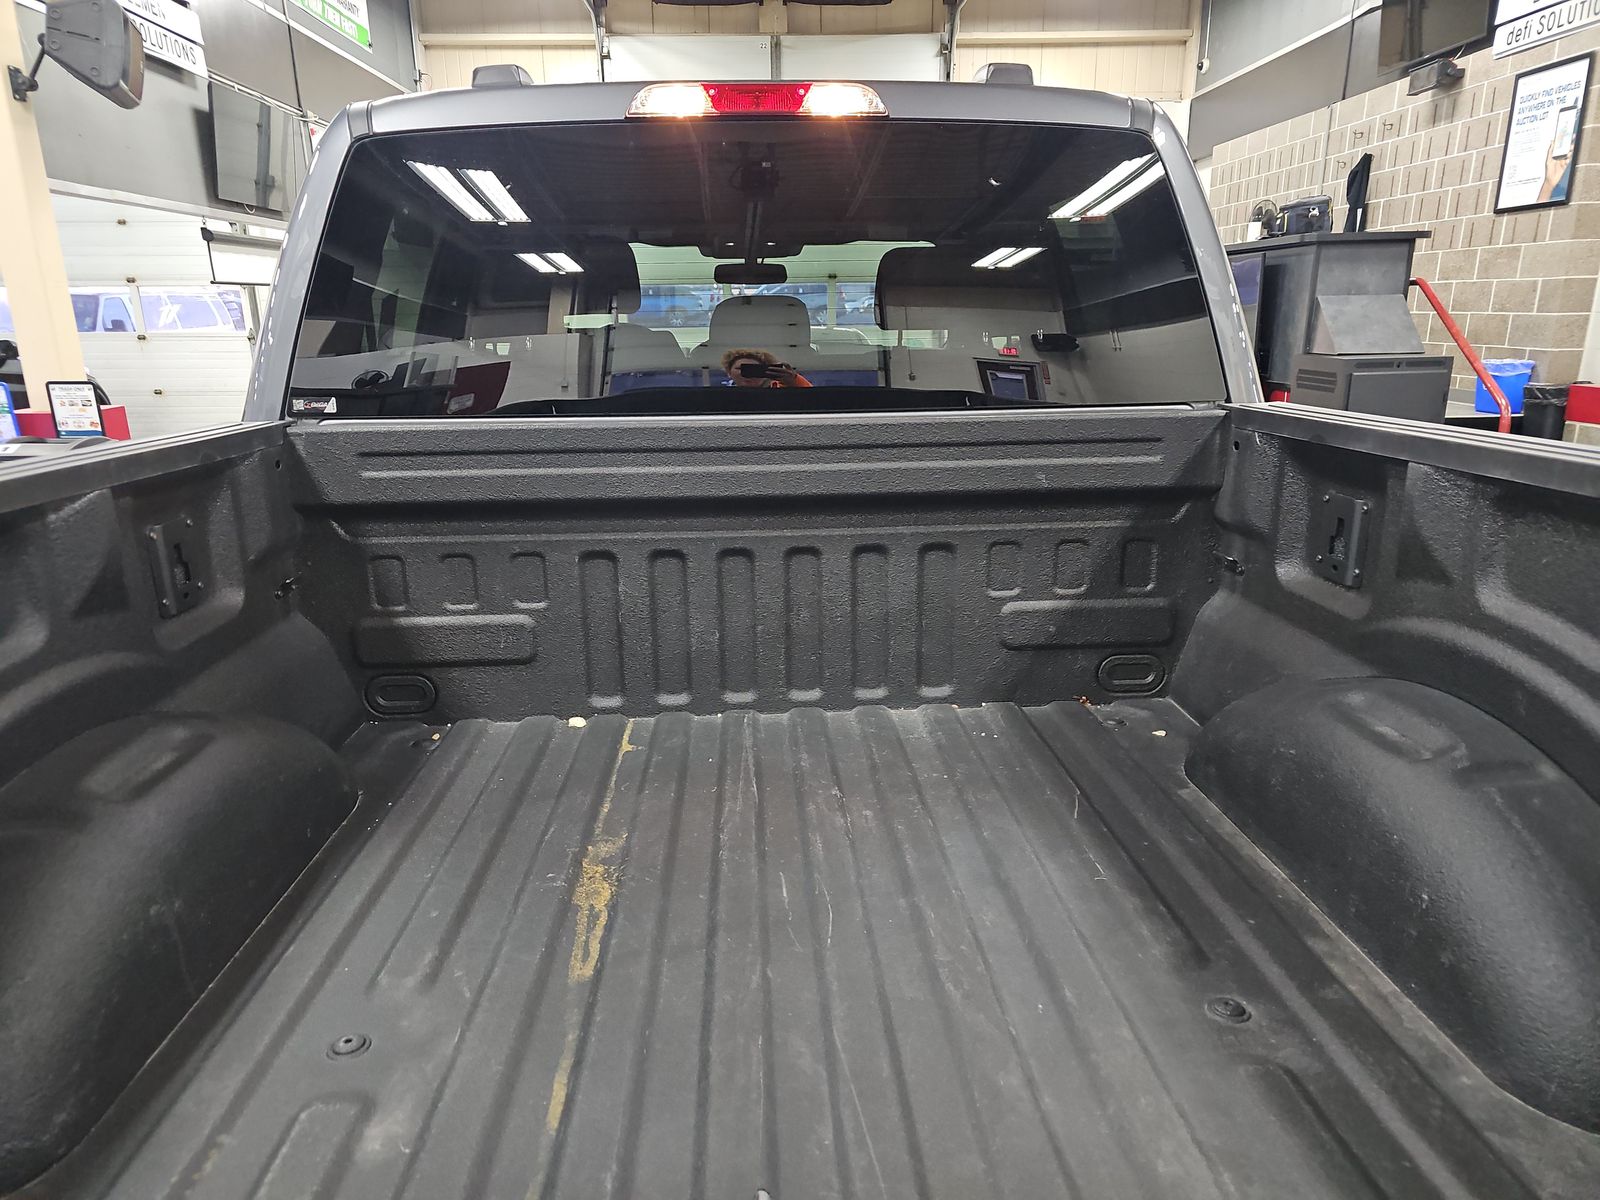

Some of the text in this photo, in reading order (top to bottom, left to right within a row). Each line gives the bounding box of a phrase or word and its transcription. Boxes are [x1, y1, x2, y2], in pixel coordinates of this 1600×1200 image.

[1506, 19, 1534, 46] defi
[1519, 80, 1582, 105] QUICKLY FIND VEHICLES
[1518, 95, 1567, 115] ANYWHERE ON THE
[1515, 111, 1550, 126] AUCTION LOT
